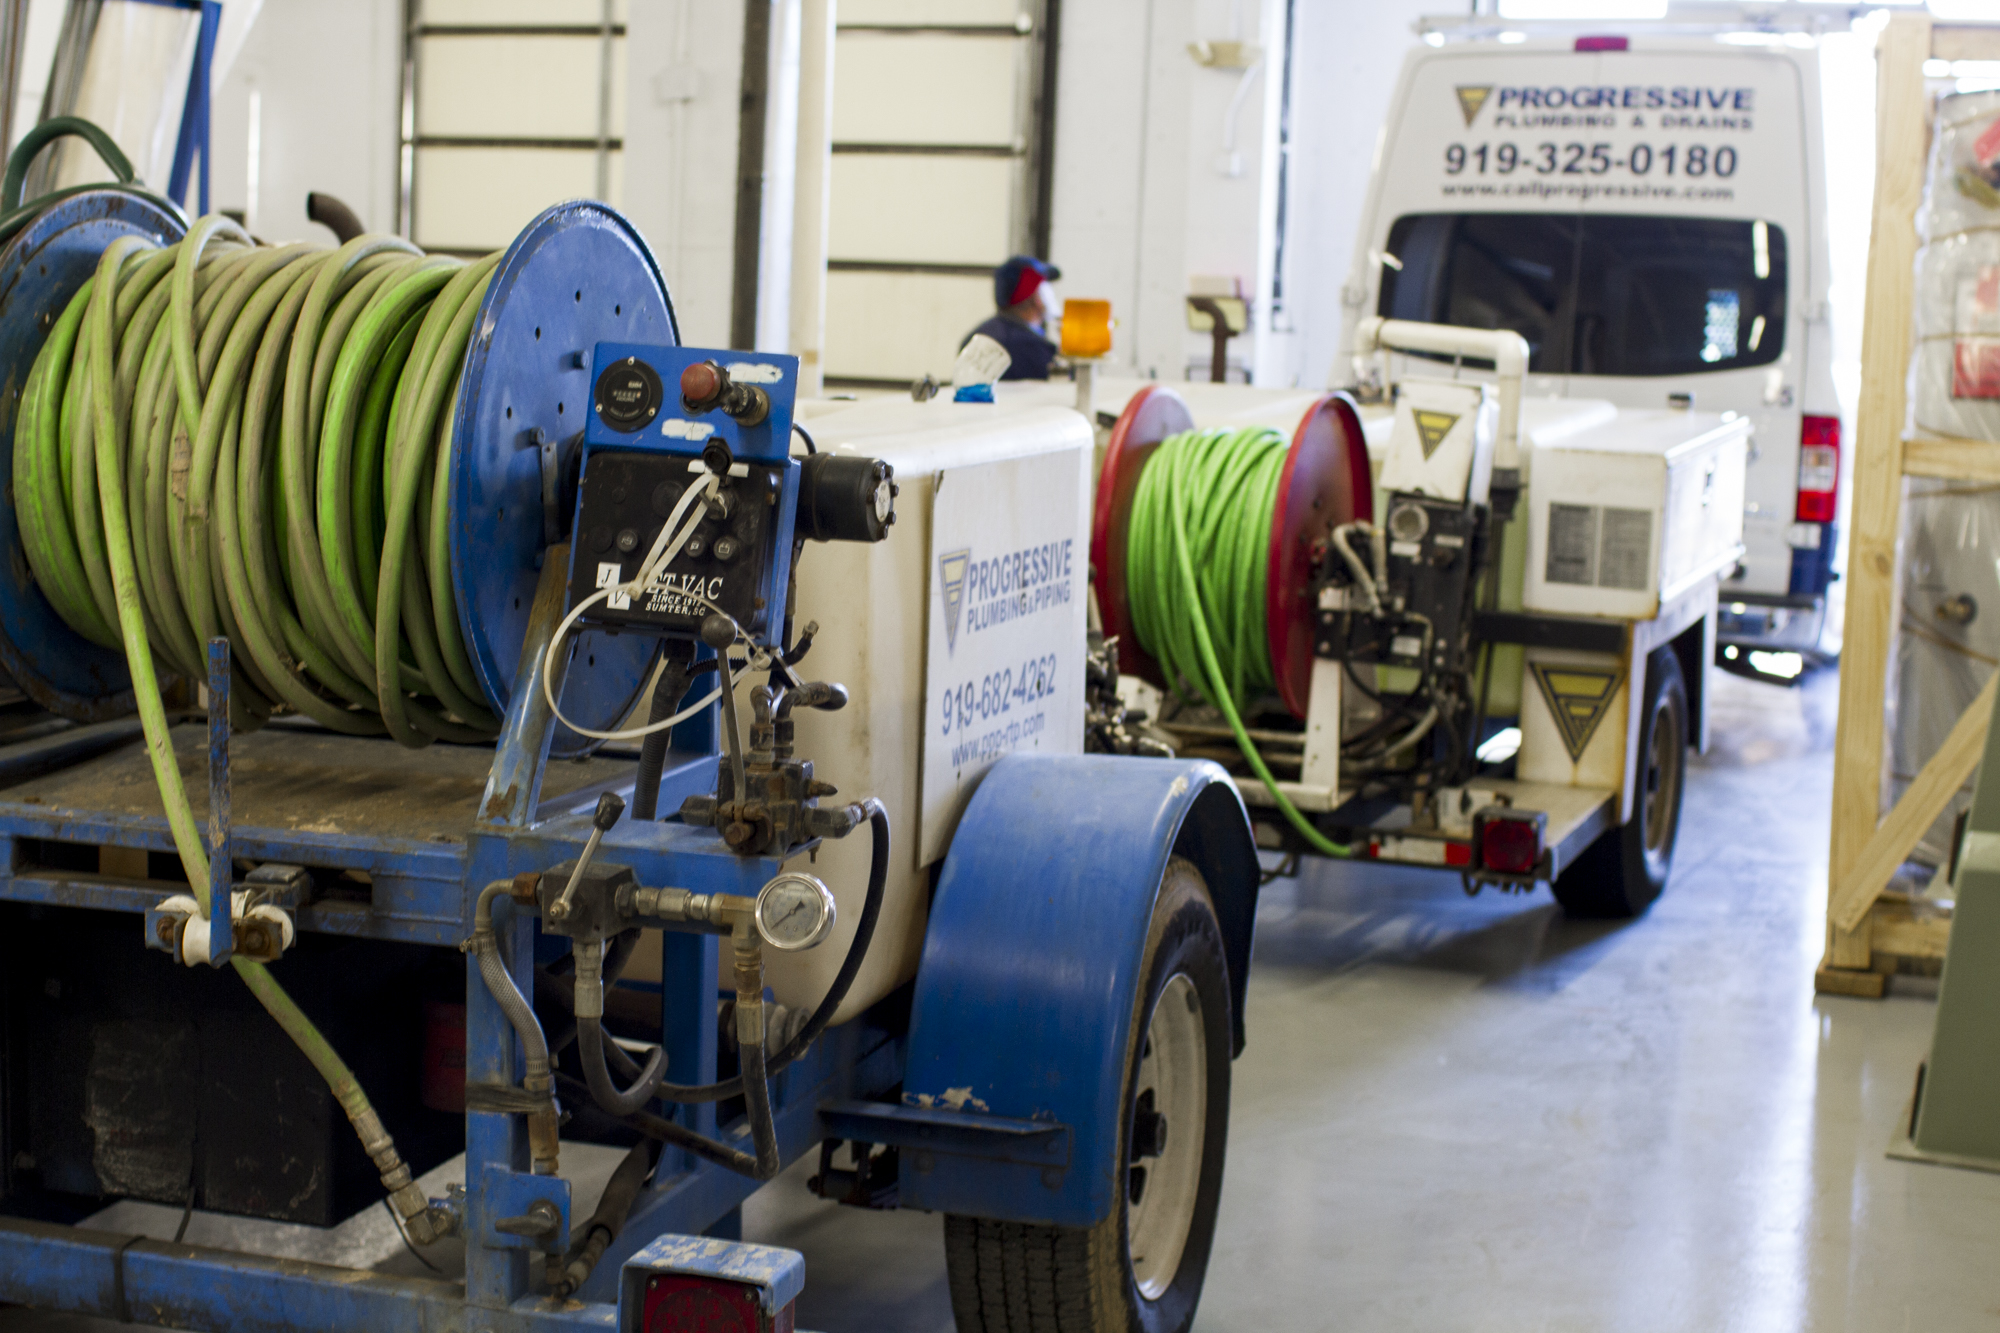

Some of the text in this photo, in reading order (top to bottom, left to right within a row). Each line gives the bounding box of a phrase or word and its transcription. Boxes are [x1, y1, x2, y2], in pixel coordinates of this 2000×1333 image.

[1498, 86, 1754, 110] PROGRESSIVE
[1495, 114, 1617, 129] PLUMBING
[1661, 115, 1752, 130] DRAINS
[1445, 143, 1738, 177] 919-325-0180
[1441, 181, 1734, 201] www.callprogressive.com
[969, 538, 1072, 604] PROGRESSIVE
[652, 594, 681, 606] SINCE
[682, 574, 723, 600] VAC
[942, 653, 1056, 736] 919-682-4262
[951, 712, 1045, 767] www.ppp-rtp.com
